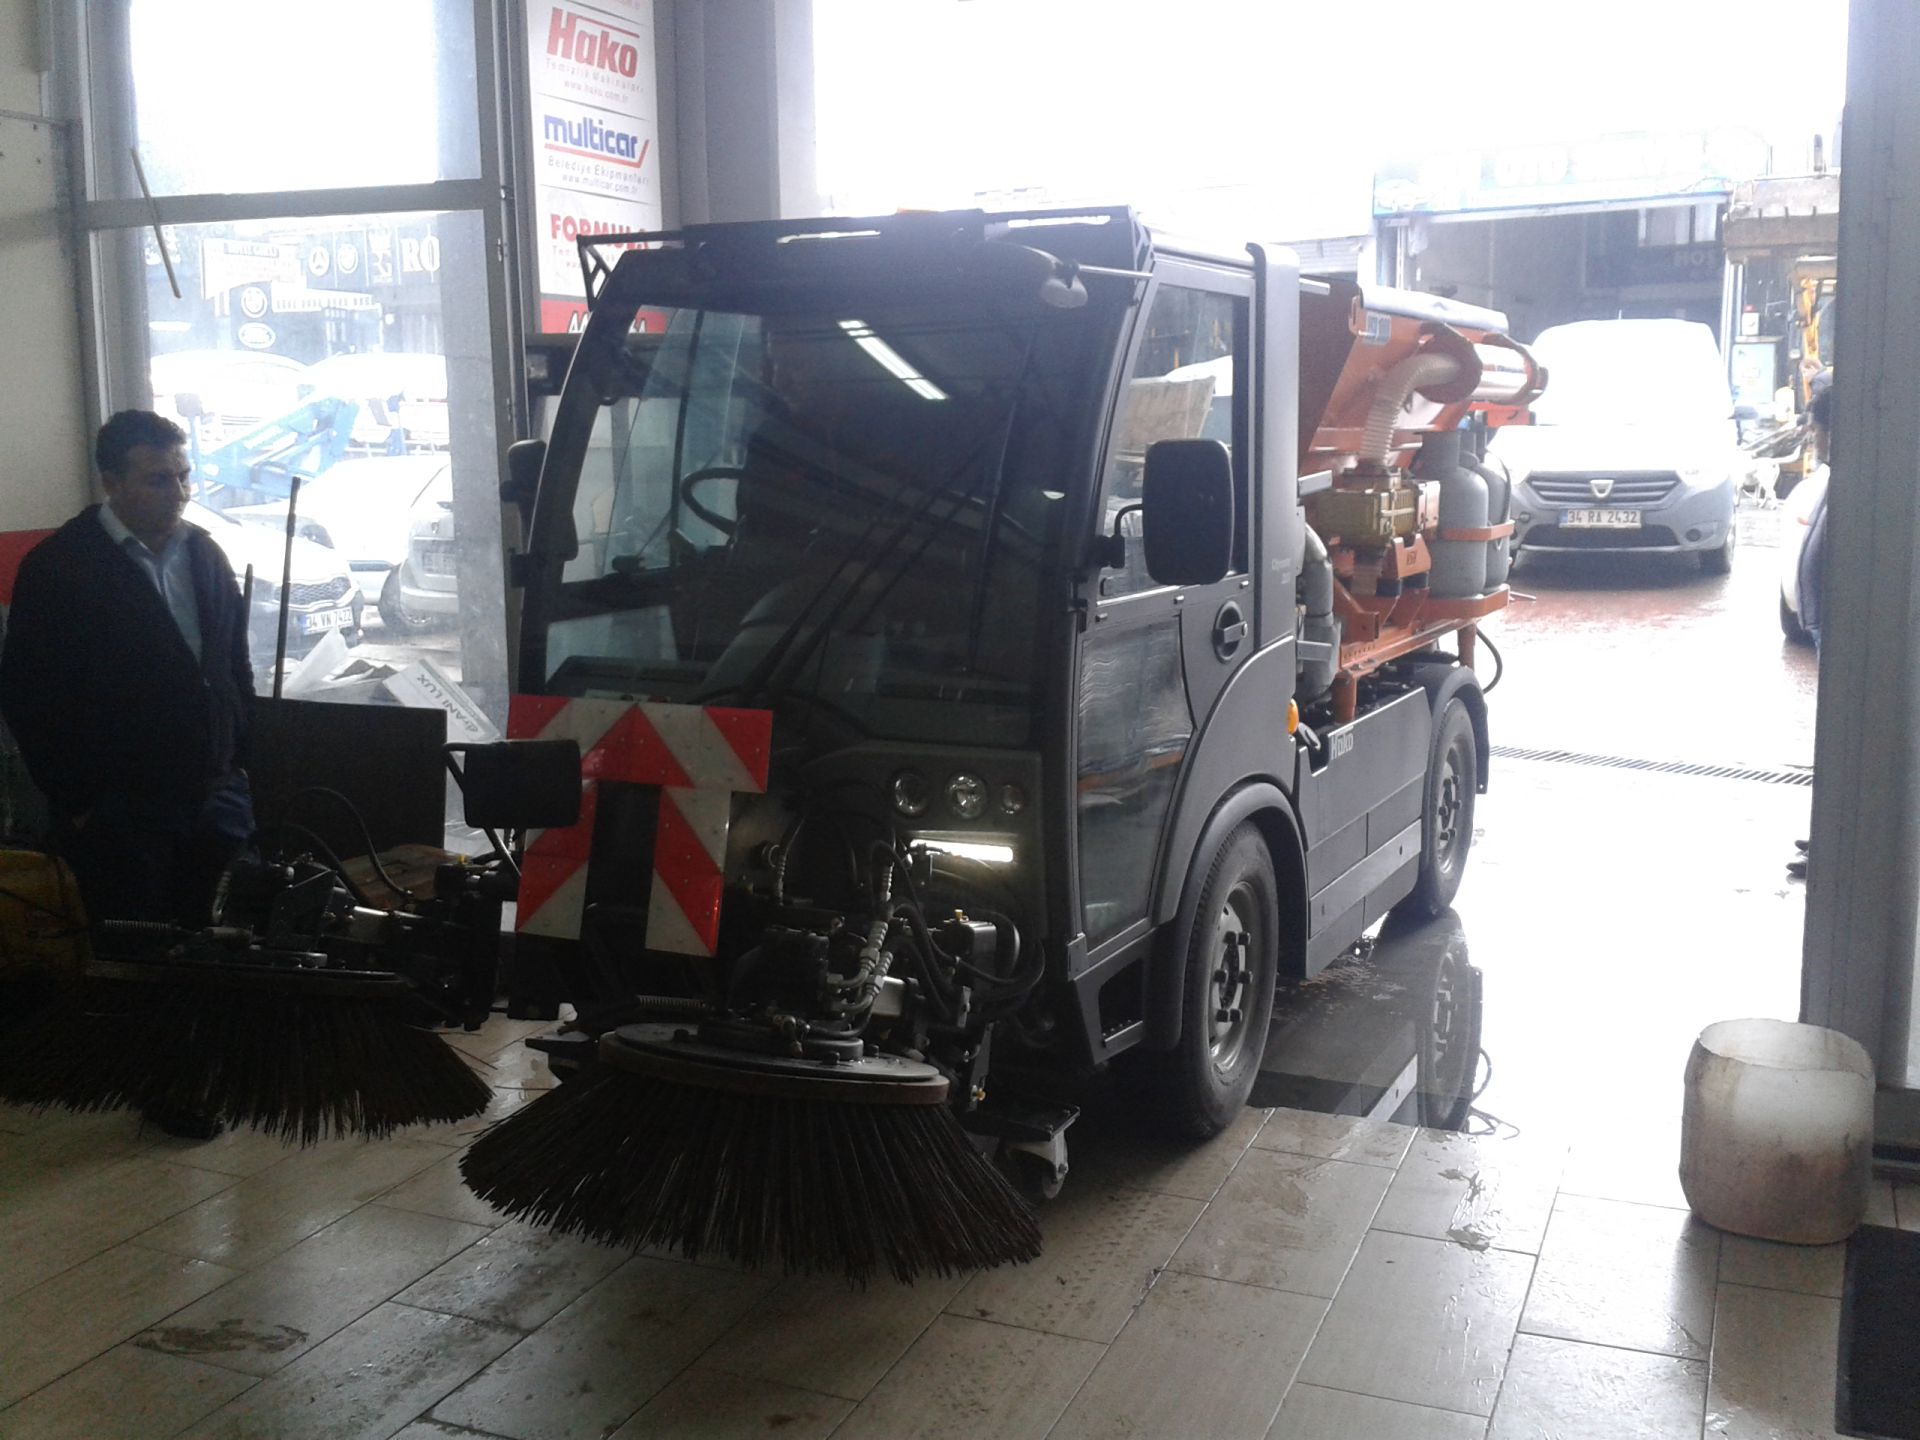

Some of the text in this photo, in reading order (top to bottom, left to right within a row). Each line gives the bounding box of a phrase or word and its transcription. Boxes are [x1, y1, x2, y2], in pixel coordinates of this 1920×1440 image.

[547, 7, 640, 78] Hako
[544, 114, 639, 159] multicar
[548, 155, 592, 175] Belediye
[1568, 511, 1638, 523] 34 RA 2432
[1330, 729, 1354, 760] Hako
